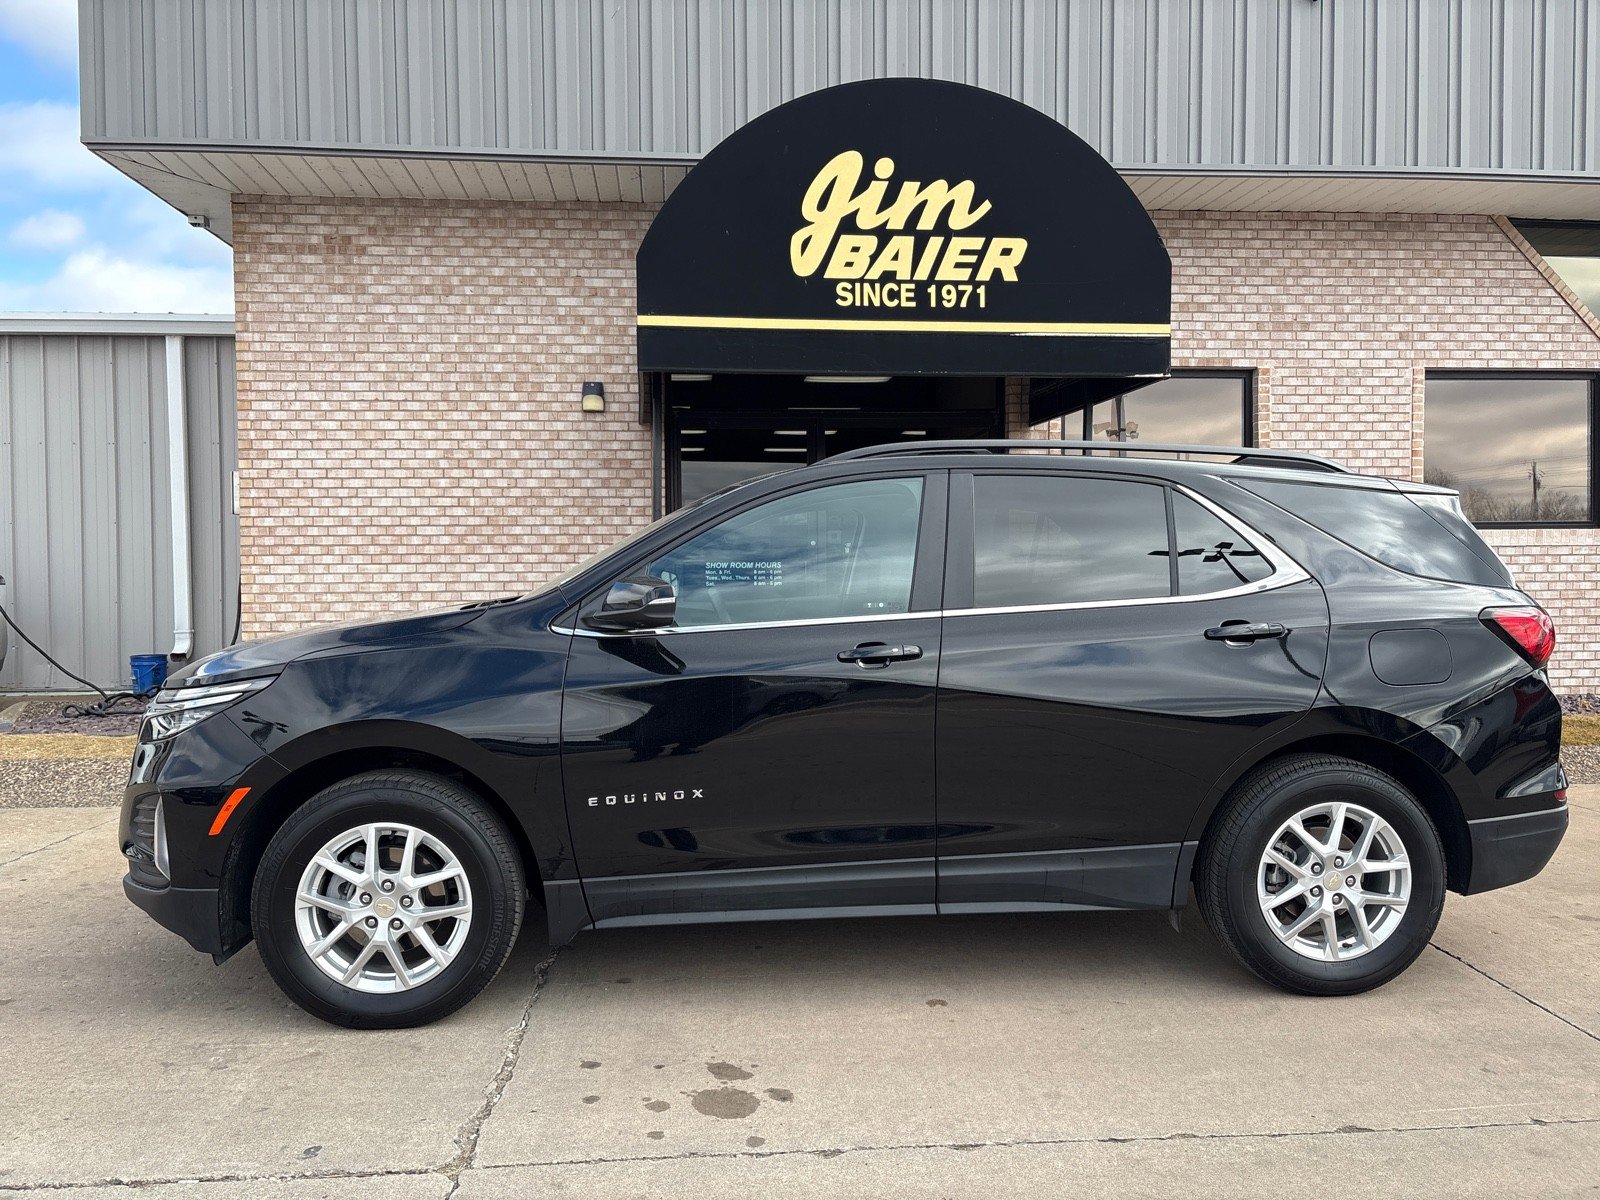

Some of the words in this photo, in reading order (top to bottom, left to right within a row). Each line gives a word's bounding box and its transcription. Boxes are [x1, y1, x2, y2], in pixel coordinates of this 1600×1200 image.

[790, 150, 992, 277] Jim
[823, 234, 1028, 282] BAIER
[835, 282, 917, 308] SINCE
[927, 284, 986, 309] 1971
[755, 561, 782, 569] HOURS
[587, 788, 704, 807] EQUINOX
